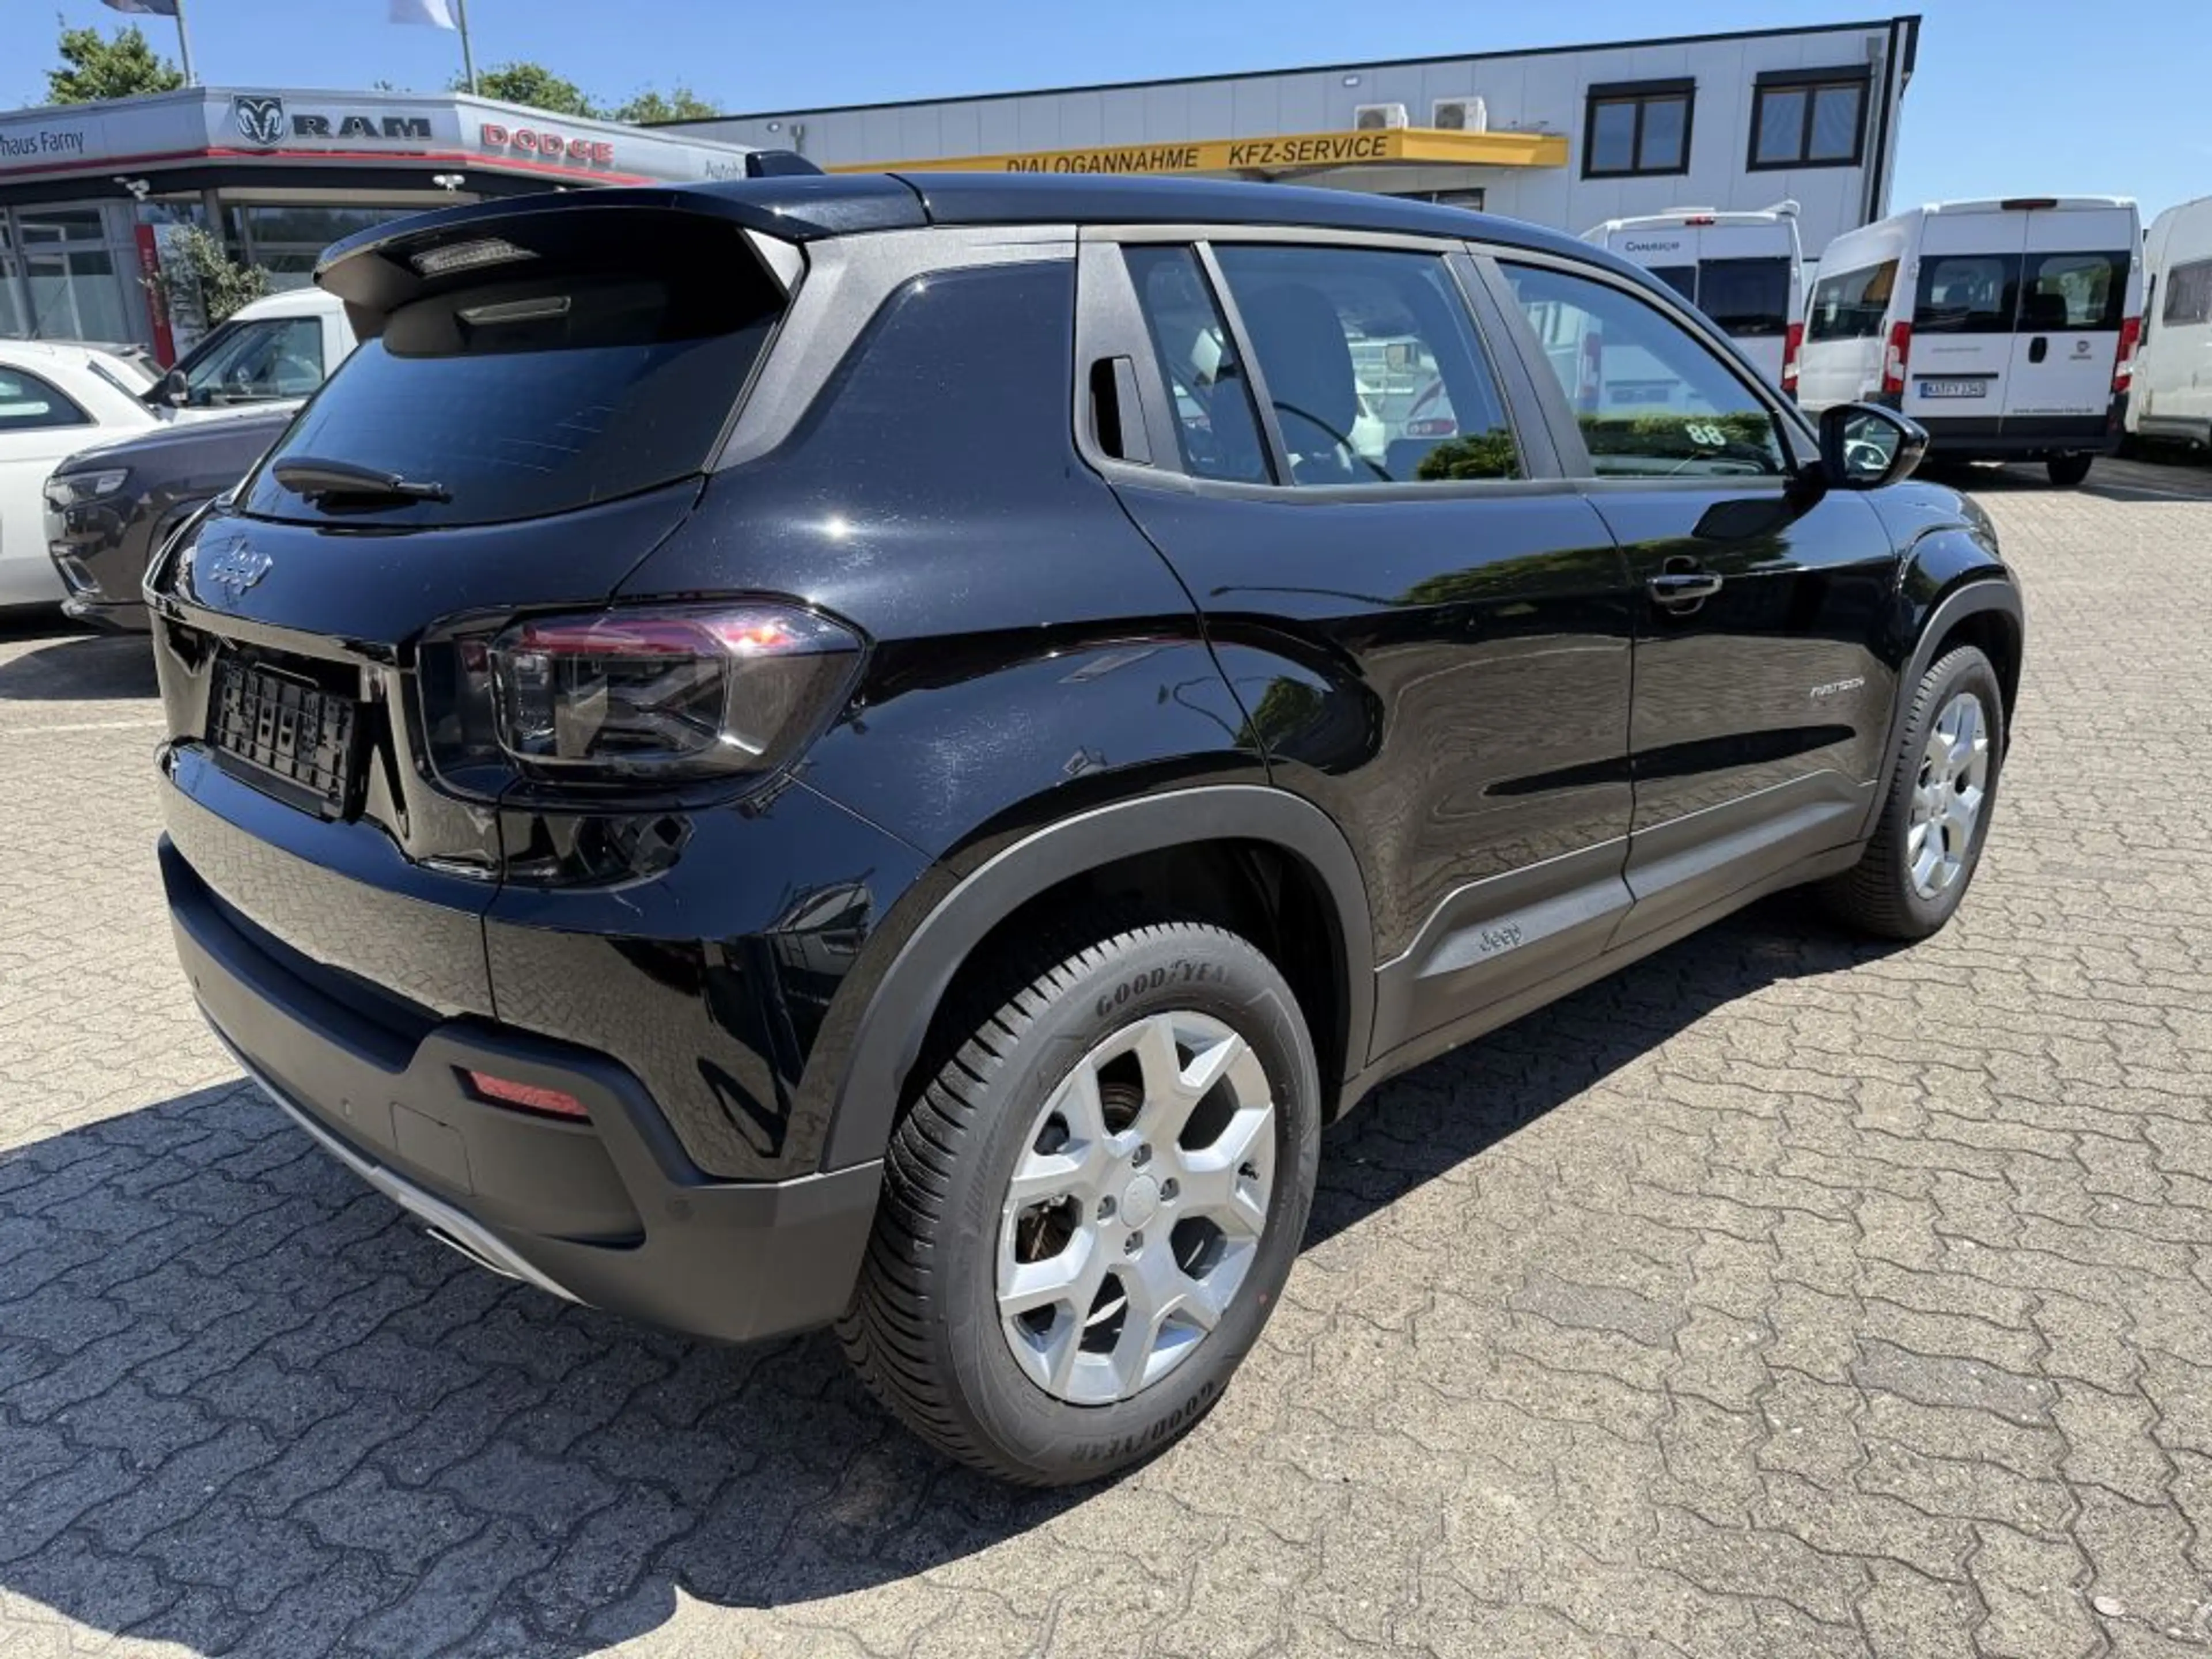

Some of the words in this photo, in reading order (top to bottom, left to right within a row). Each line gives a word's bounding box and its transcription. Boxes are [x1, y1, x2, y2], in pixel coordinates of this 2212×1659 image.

[291, 115, 432, 139] RAM
[40, 131, 84, 154] Farny
[483, 123, 615, 164] DODGE
[1007, 148, 1199, 173] DIALOGANNAHME
[1229, 136, 1388, 165] KFZ-SERVICE
